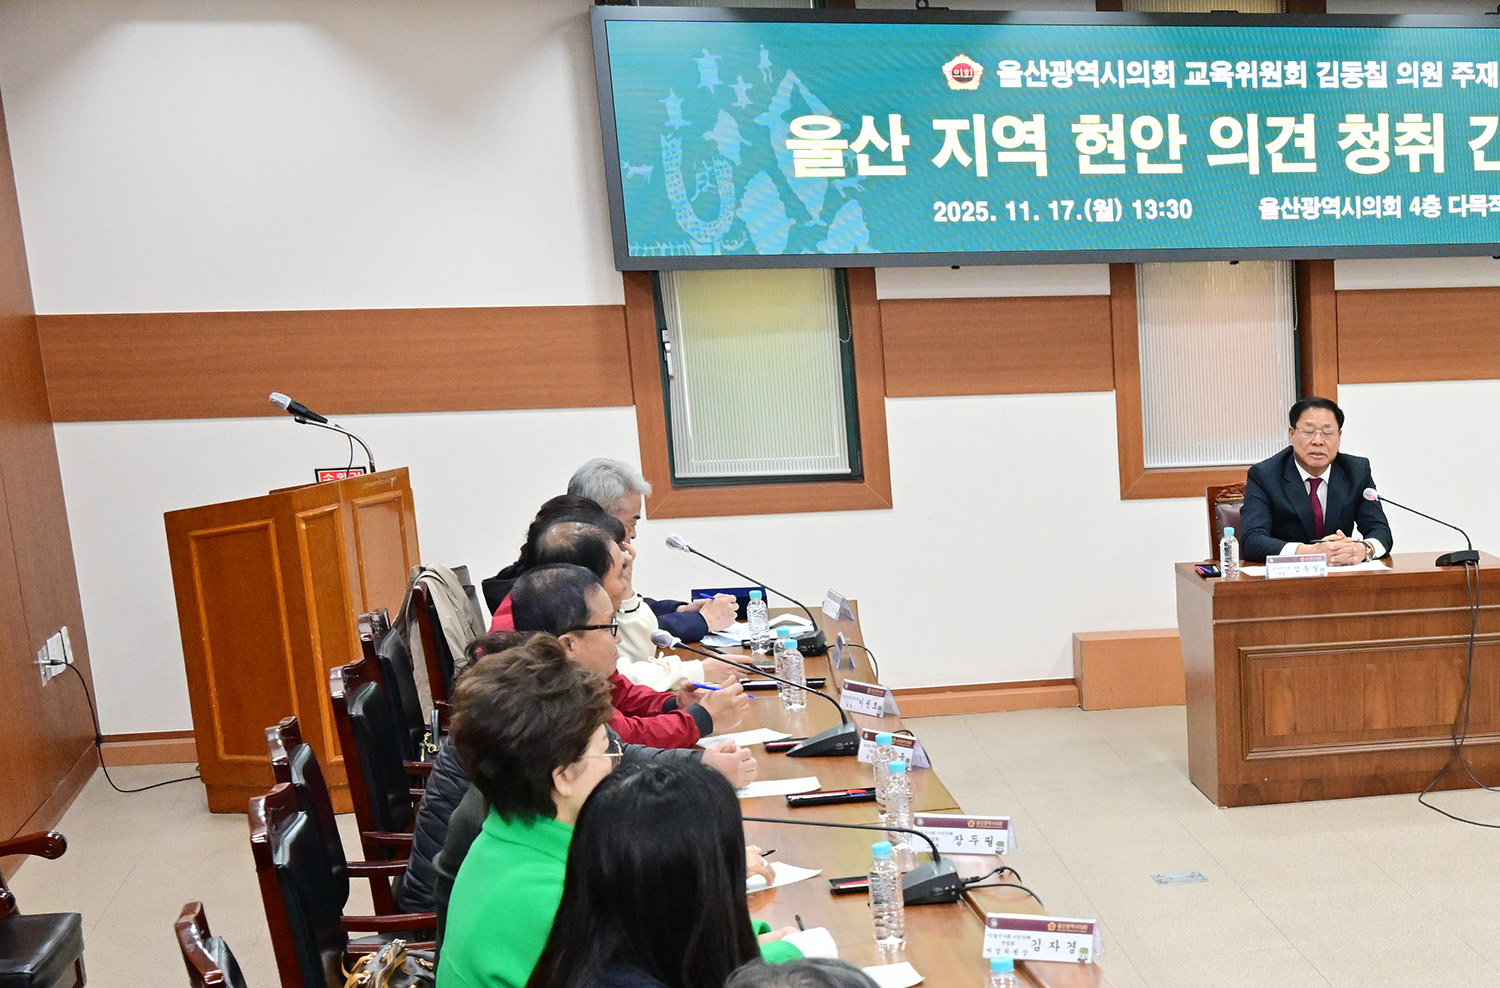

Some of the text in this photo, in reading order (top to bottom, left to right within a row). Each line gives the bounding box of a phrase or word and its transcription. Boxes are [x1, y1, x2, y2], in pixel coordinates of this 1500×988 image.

[953, 67, 974, 79] 의회
[997, 60, 1499, 88] 울산광역시의회 교육위원회 김동칠 의원 주재
[785, 114, 910, 177] 울산
[931, 114, 1048, 177] 지역
[1071, 114, 1188, 175] 현안
[1206, 114, 1317, 175] 의견
[1337, 113, 1445, 174] 청취
[933, 201, 997, 222] 2025.
[1006, 200, 1040, 221] 11.
[1048, 198, 1123, 222] 17.(월)
[1132, 199, 1193, 220] 13:30
[1259, 194, 1402, 220] 울산광역시의회
[1409, 194, 1443, 218] 4층
[1032, 938, 1077, 955] 김자경
